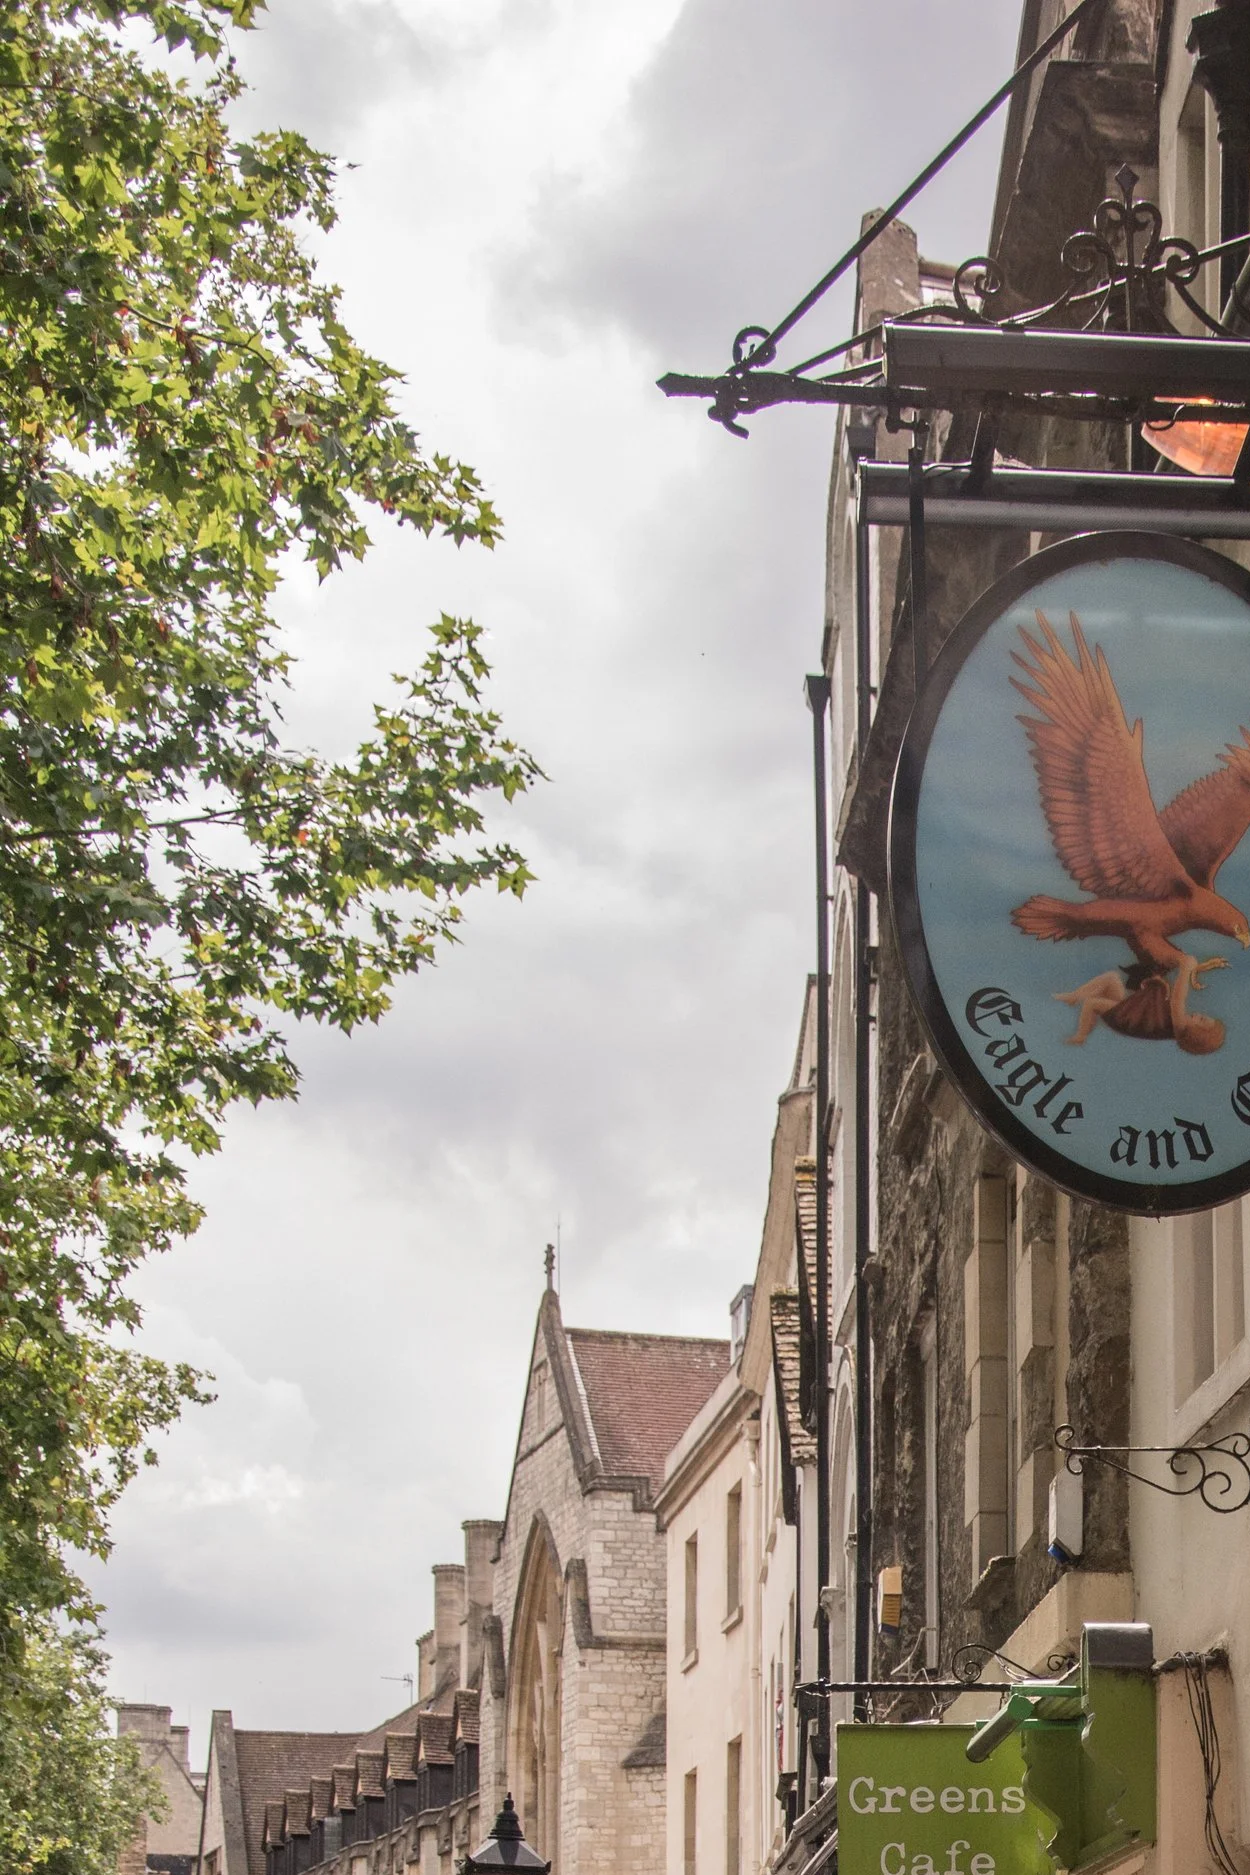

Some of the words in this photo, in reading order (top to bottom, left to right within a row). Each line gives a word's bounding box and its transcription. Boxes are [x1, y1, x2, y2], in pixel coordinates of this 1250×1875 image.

[965, 986, 1085, 1135] Eagle
[1109, 1116, 1215, 1169] and
[847, 1776, 1026, 1815] Greens
